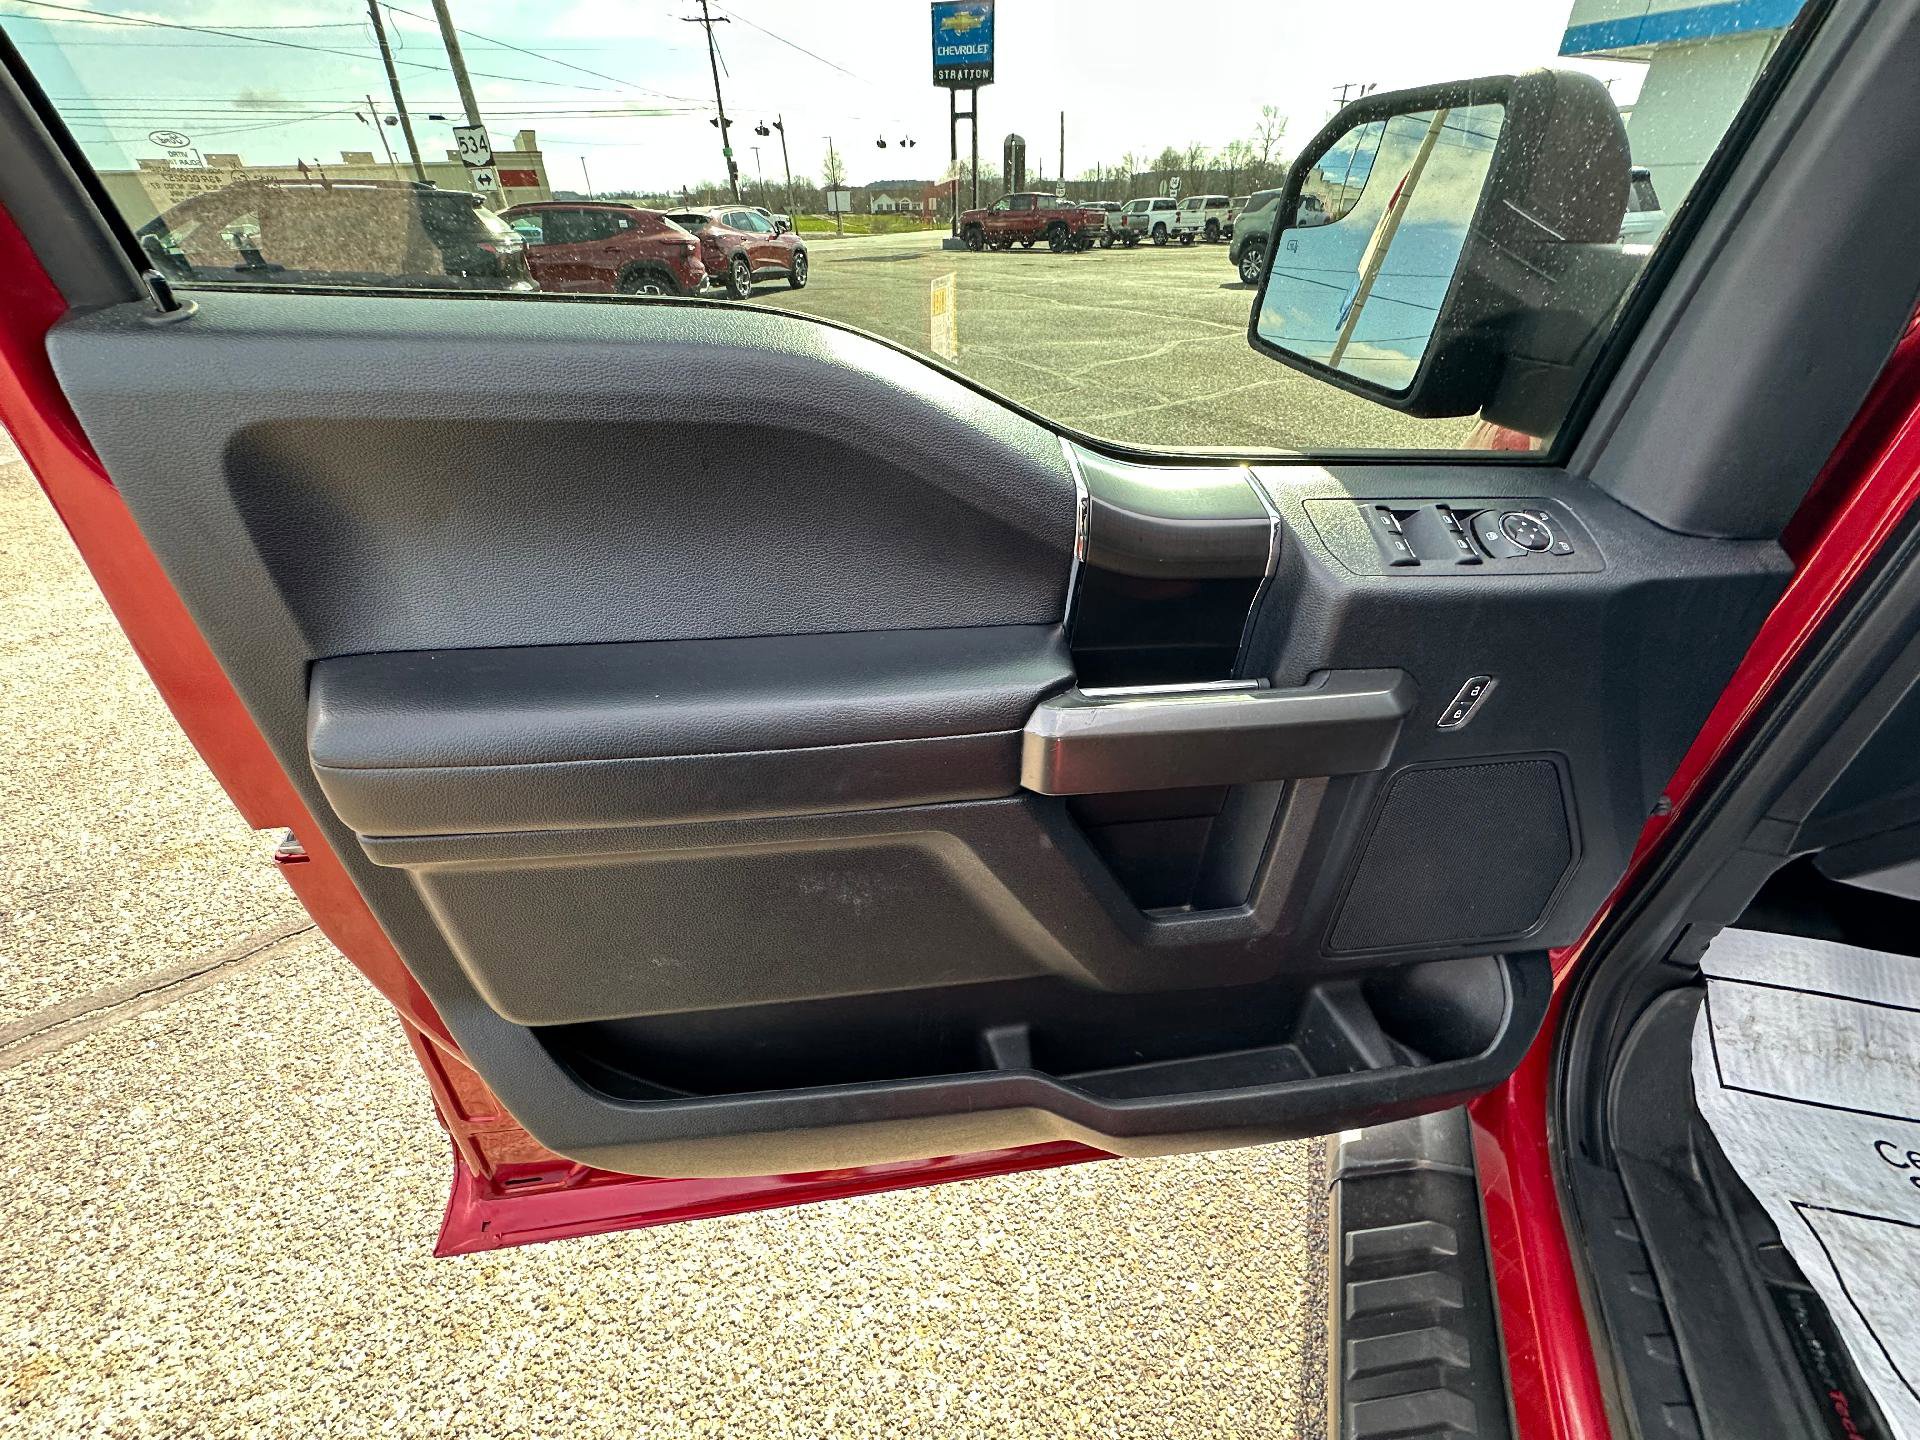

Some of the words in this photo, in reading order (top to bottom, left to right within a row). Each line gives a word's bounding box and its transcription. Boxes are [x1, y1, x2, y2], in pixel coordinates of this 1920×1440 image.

[937, 44, 989, 56] CHEVROLET
[938, 69, 990, 80] STRATTON
[458, 135, 488, 154] 534
